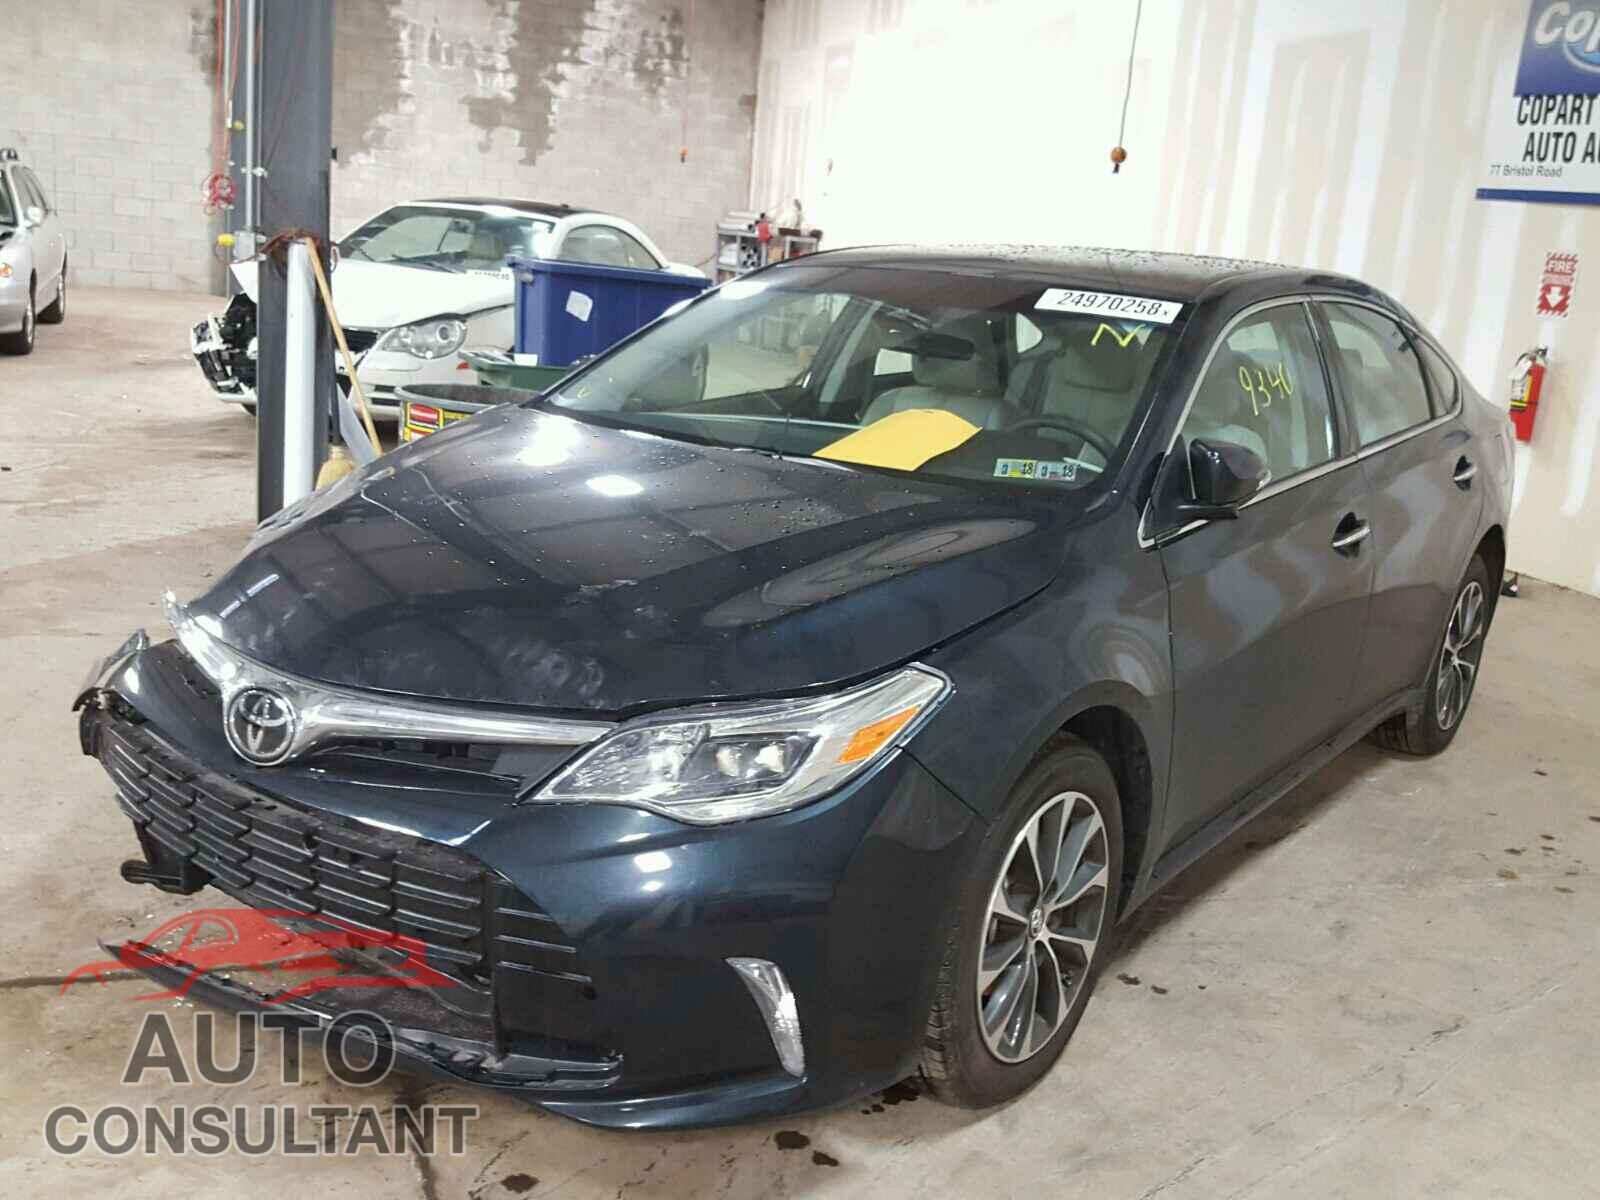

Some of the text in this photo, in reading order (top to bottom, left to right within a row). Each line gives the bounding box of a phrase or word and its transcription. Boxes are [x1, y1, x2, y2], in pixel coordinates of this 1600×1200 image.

[1517, 94, 1599, 126] COPART
[1522, 132, 1577, 164] AUTO
[1490, 164, 1563, 178] 77 Bristol Road
[1548, 260, 1575, 273] FIRE
[1057, 291, 1162, 316] 24970258
[1023, 463, 1034, 475] 18
[1063, 465, 1074, 477] 18
